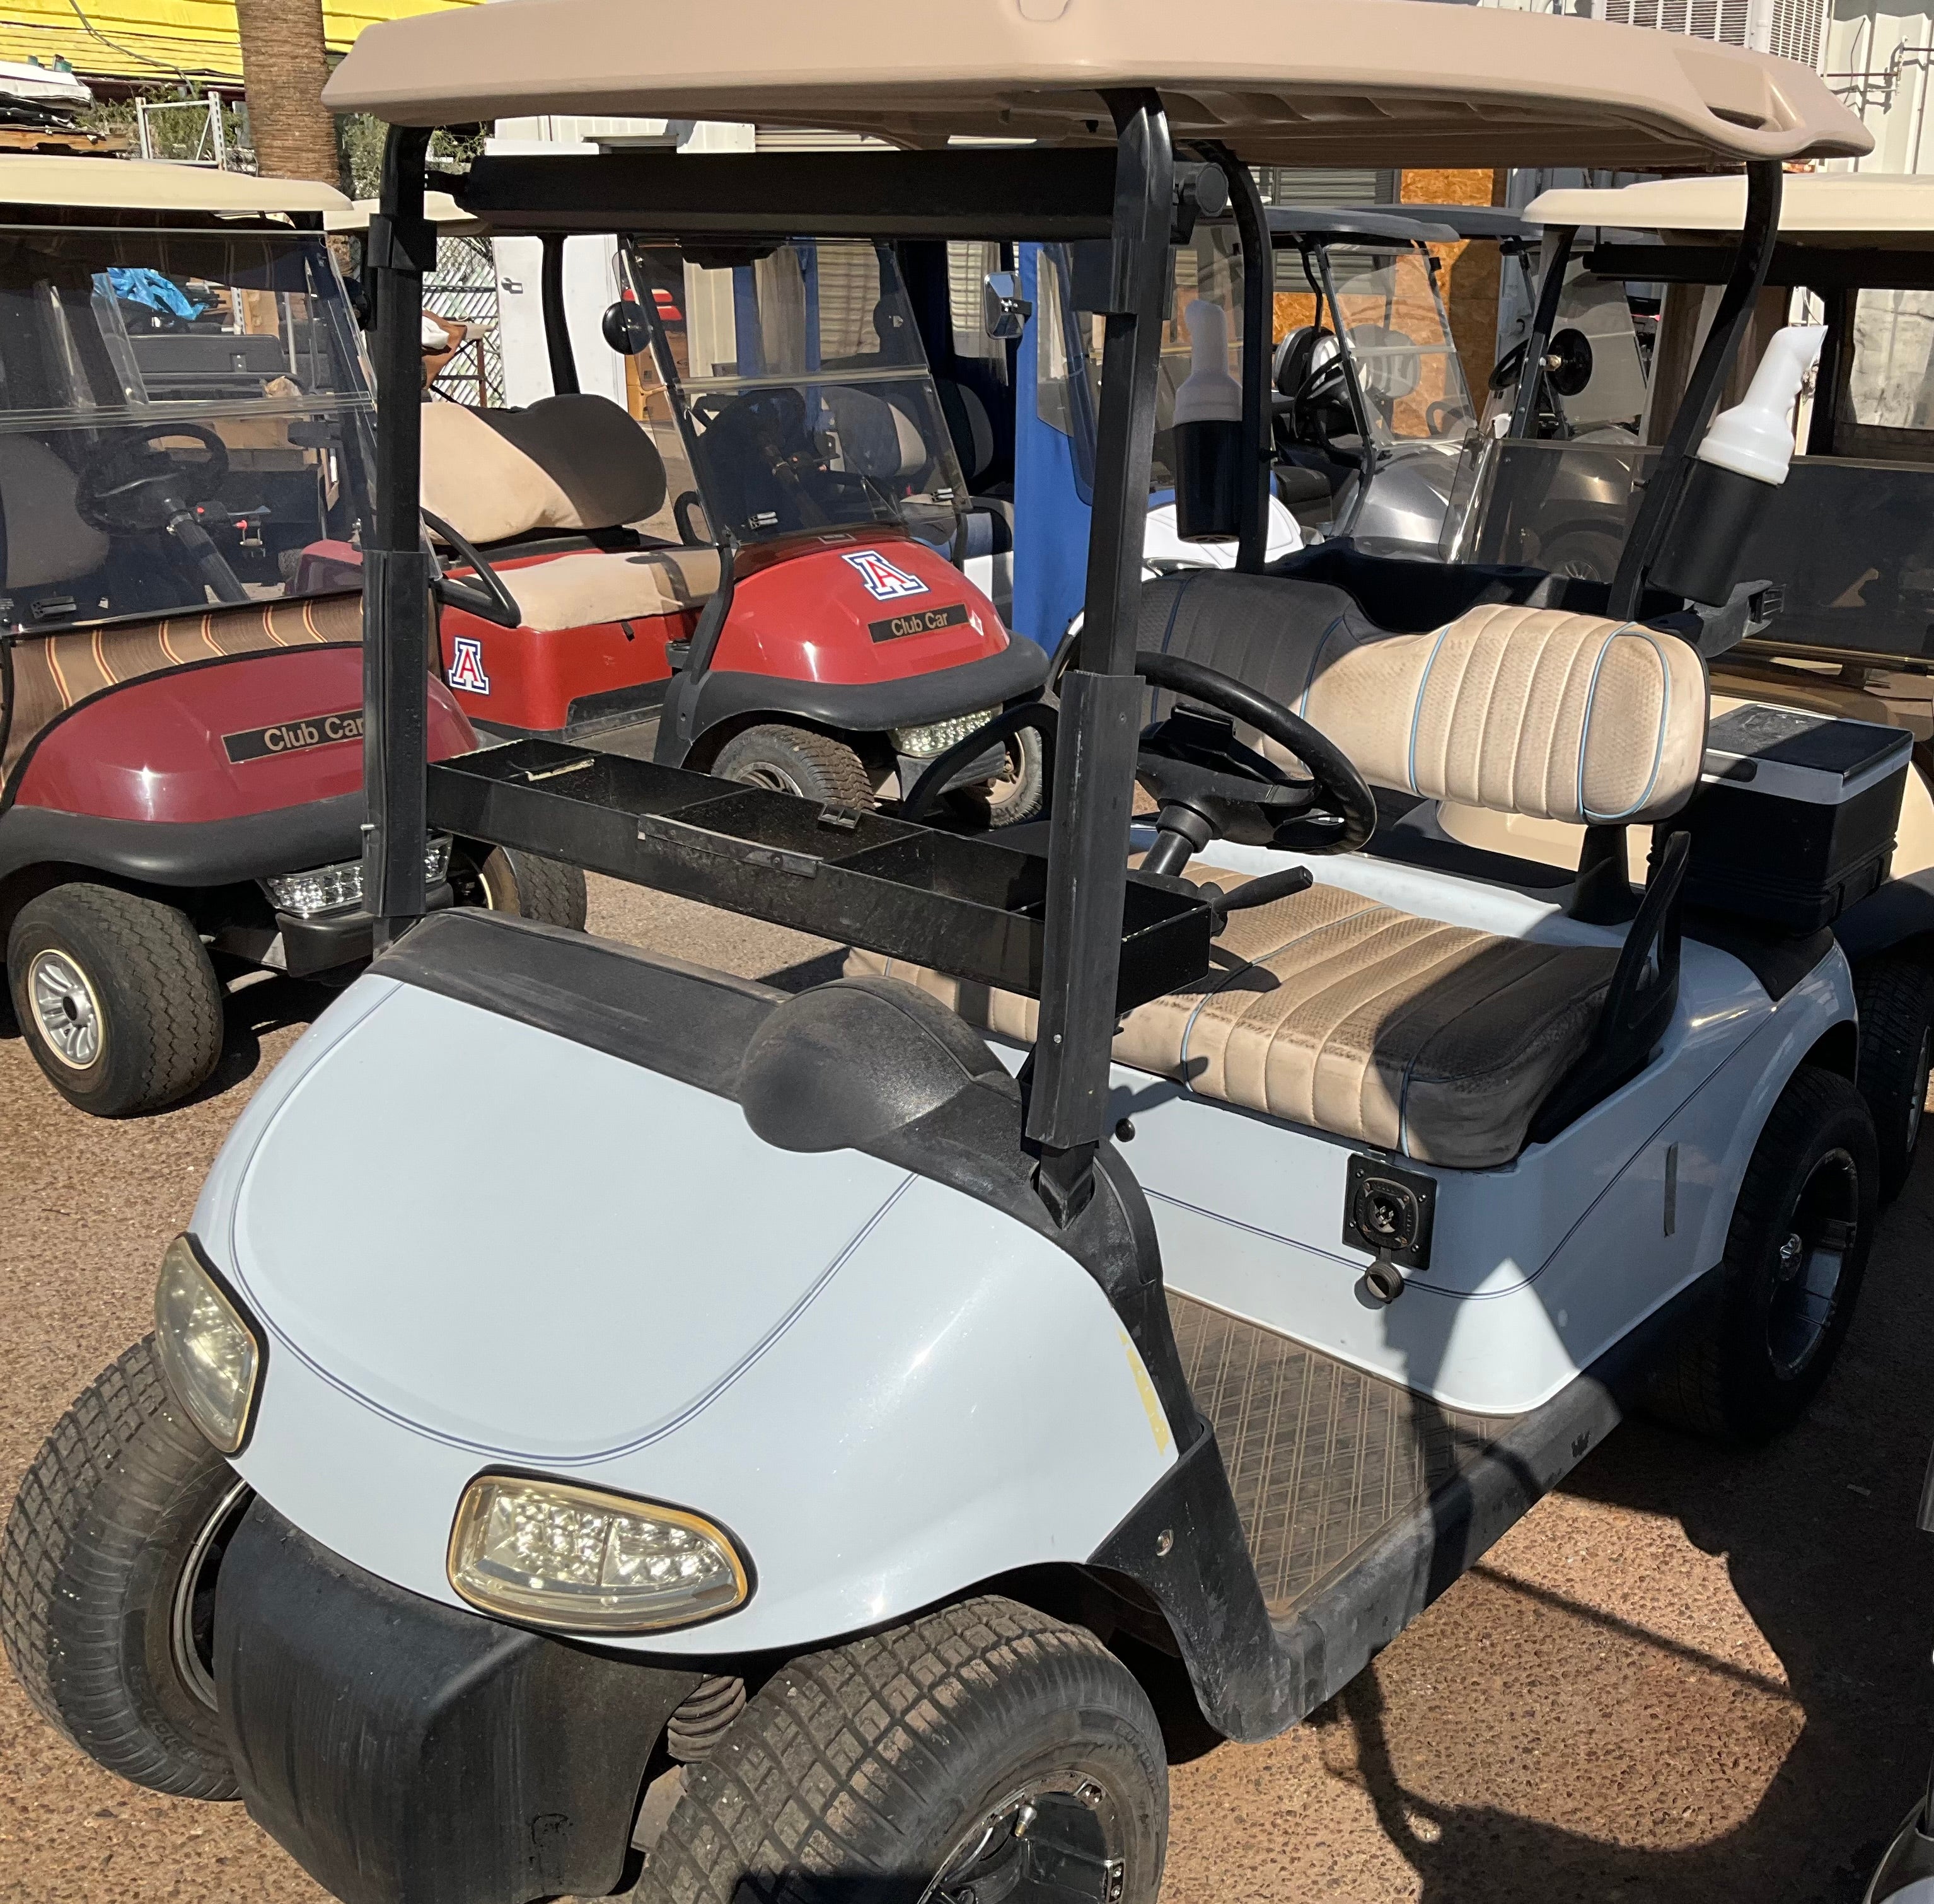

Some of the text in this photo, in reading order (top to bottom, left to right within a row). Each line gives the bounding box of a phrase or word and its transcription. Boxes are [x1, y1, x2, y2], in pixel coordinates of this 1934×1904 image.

[840, 549, 931, 601] A
[891, 612, 948, 636] Club Car
[448, 636, 490, 696] A
[263, 723, 319, 752] Club
